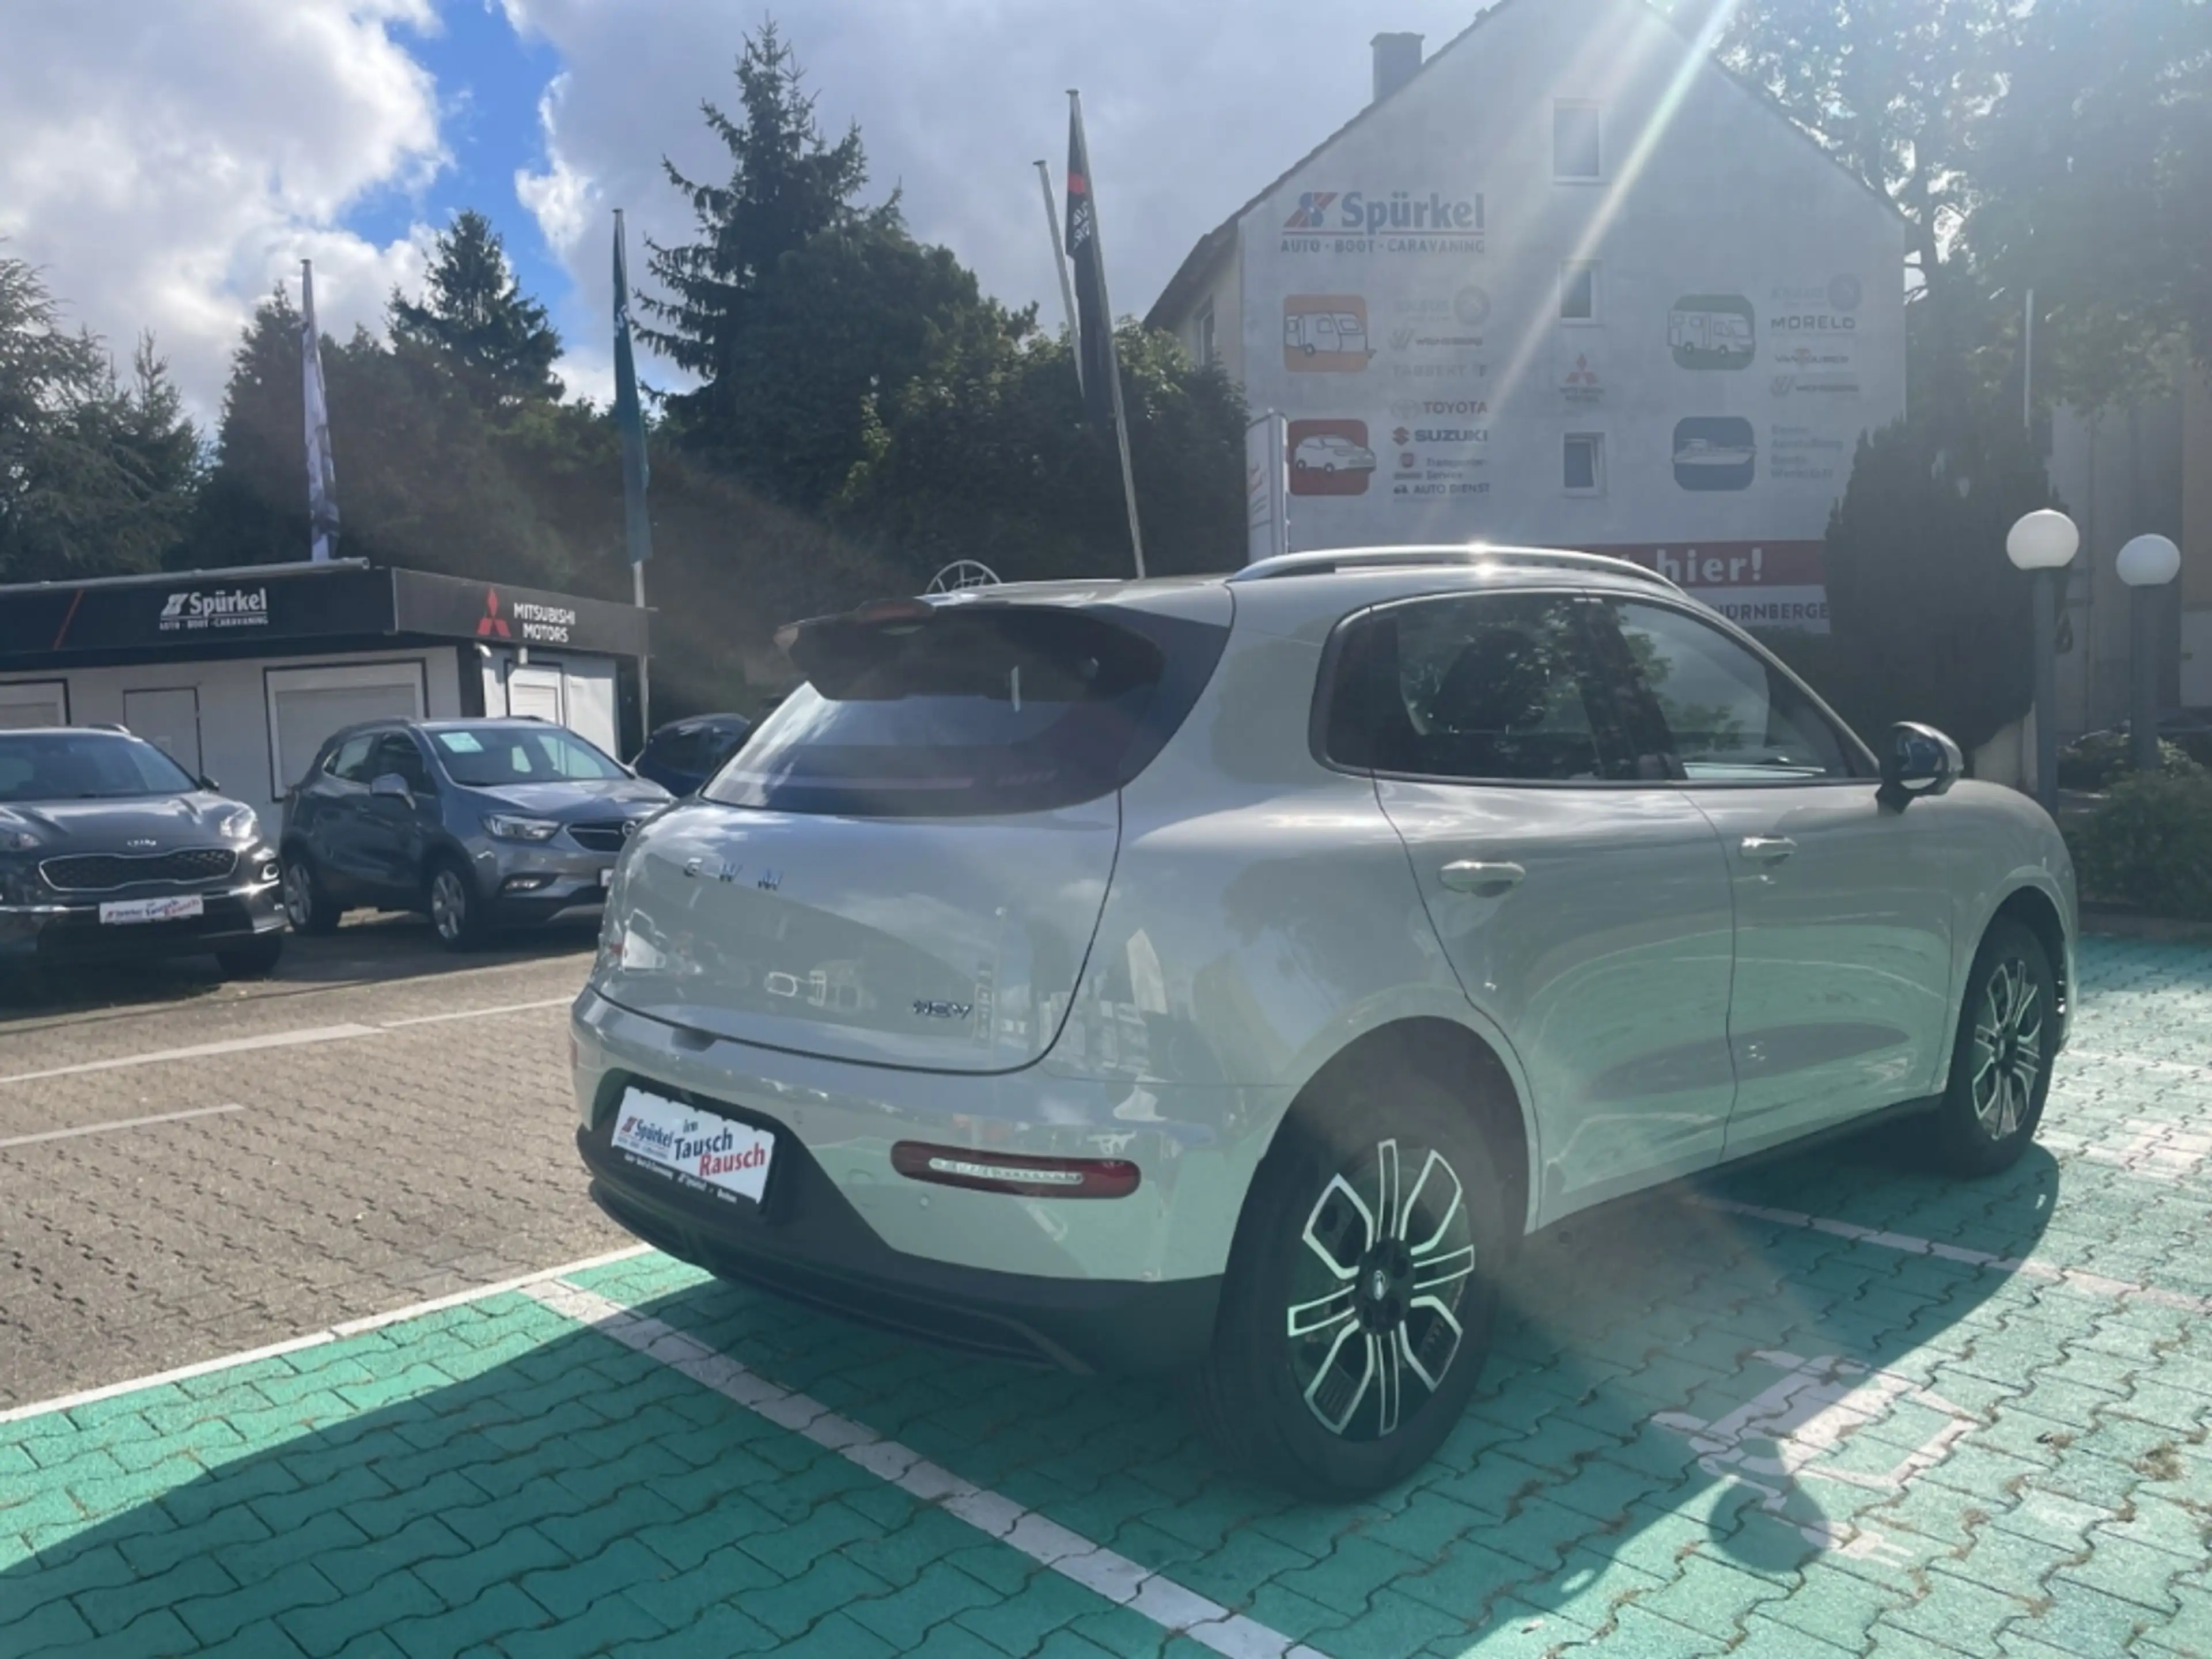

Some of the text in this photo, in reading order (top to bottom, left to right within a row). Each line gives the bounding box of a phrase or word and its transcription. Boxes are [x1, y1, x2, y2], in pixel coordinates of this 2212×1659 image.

[1340, 191, 1484, 232] Spürkel
[1281, 238, 1484, 253] AUTO BOOT CARAVANING
[1423, 401, 1487, 414] TOYOTA
[1414, 429, 1488, 442] SUZUKI
[1657, 547, 1762, 581] hier!
[190, 588, 267, 617] Spürkel
[513, 602, 576, 626] MITSUBISHI
[522, 622, 570, 643] MOTORS
[674, 1127, 734, 1161] Tausch
[699, 1141, 766, 1177] Rausch
